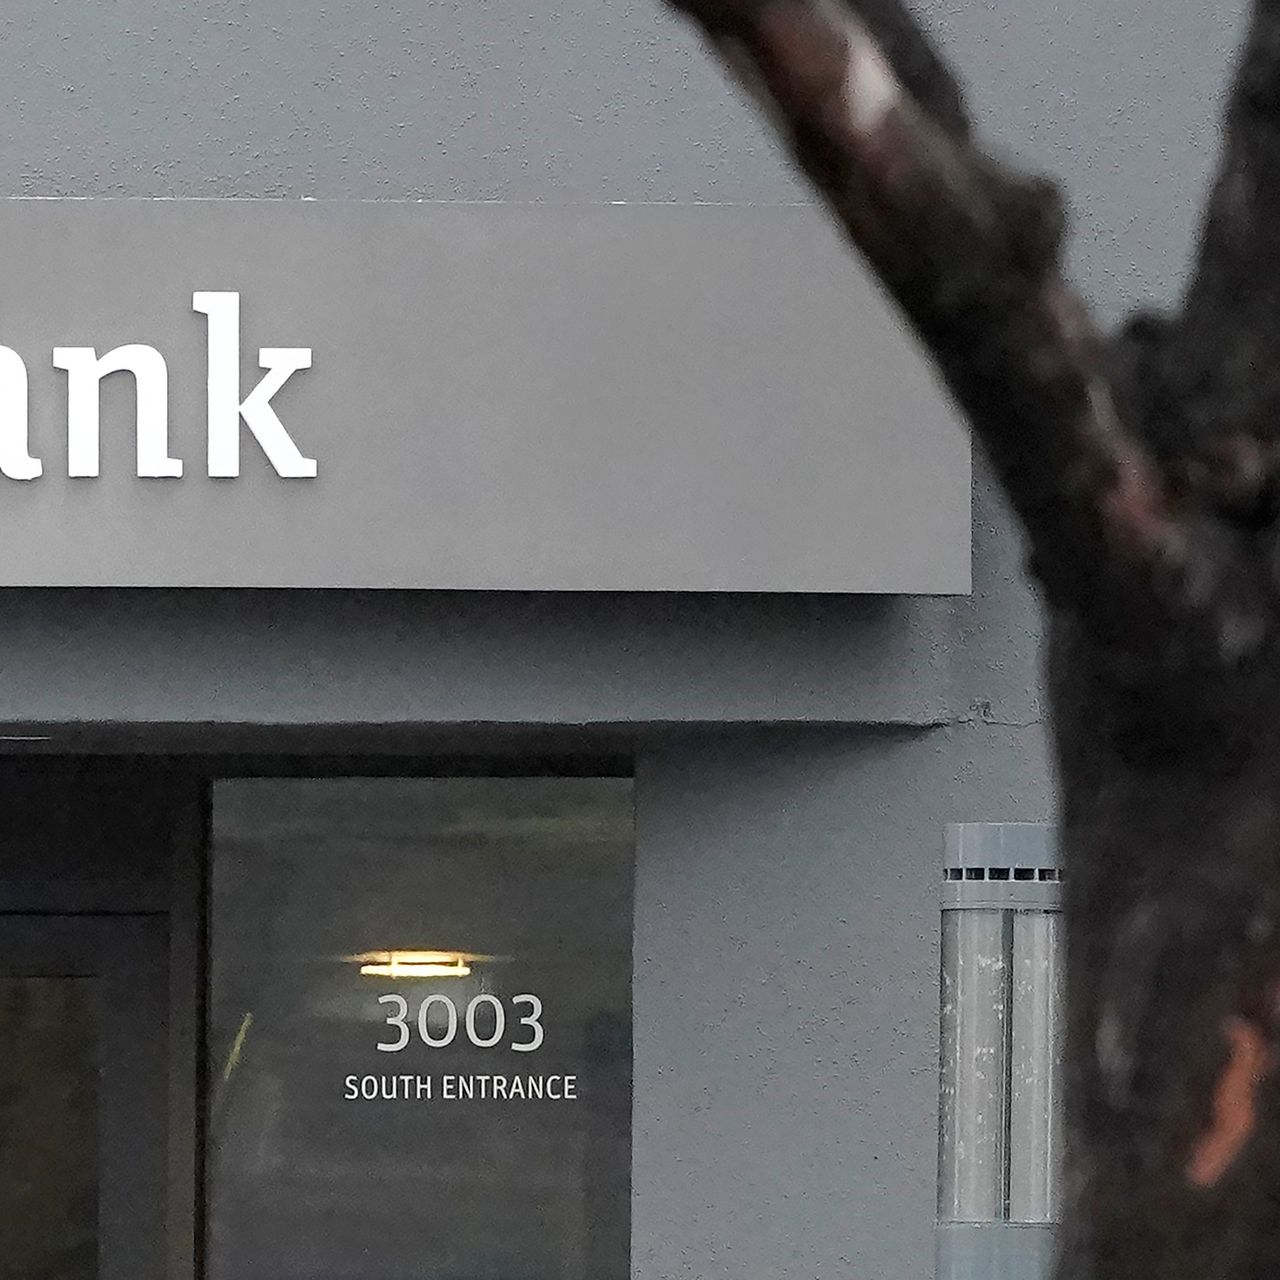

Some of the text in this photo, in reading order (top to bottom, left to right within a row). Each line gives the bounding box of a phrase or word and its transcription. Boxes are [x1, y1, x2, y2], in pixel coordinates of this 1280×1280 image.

[376, 993, 545, 1053] 3003
[343, 1074, 578, 1100] SOUTH ENTRANCE
